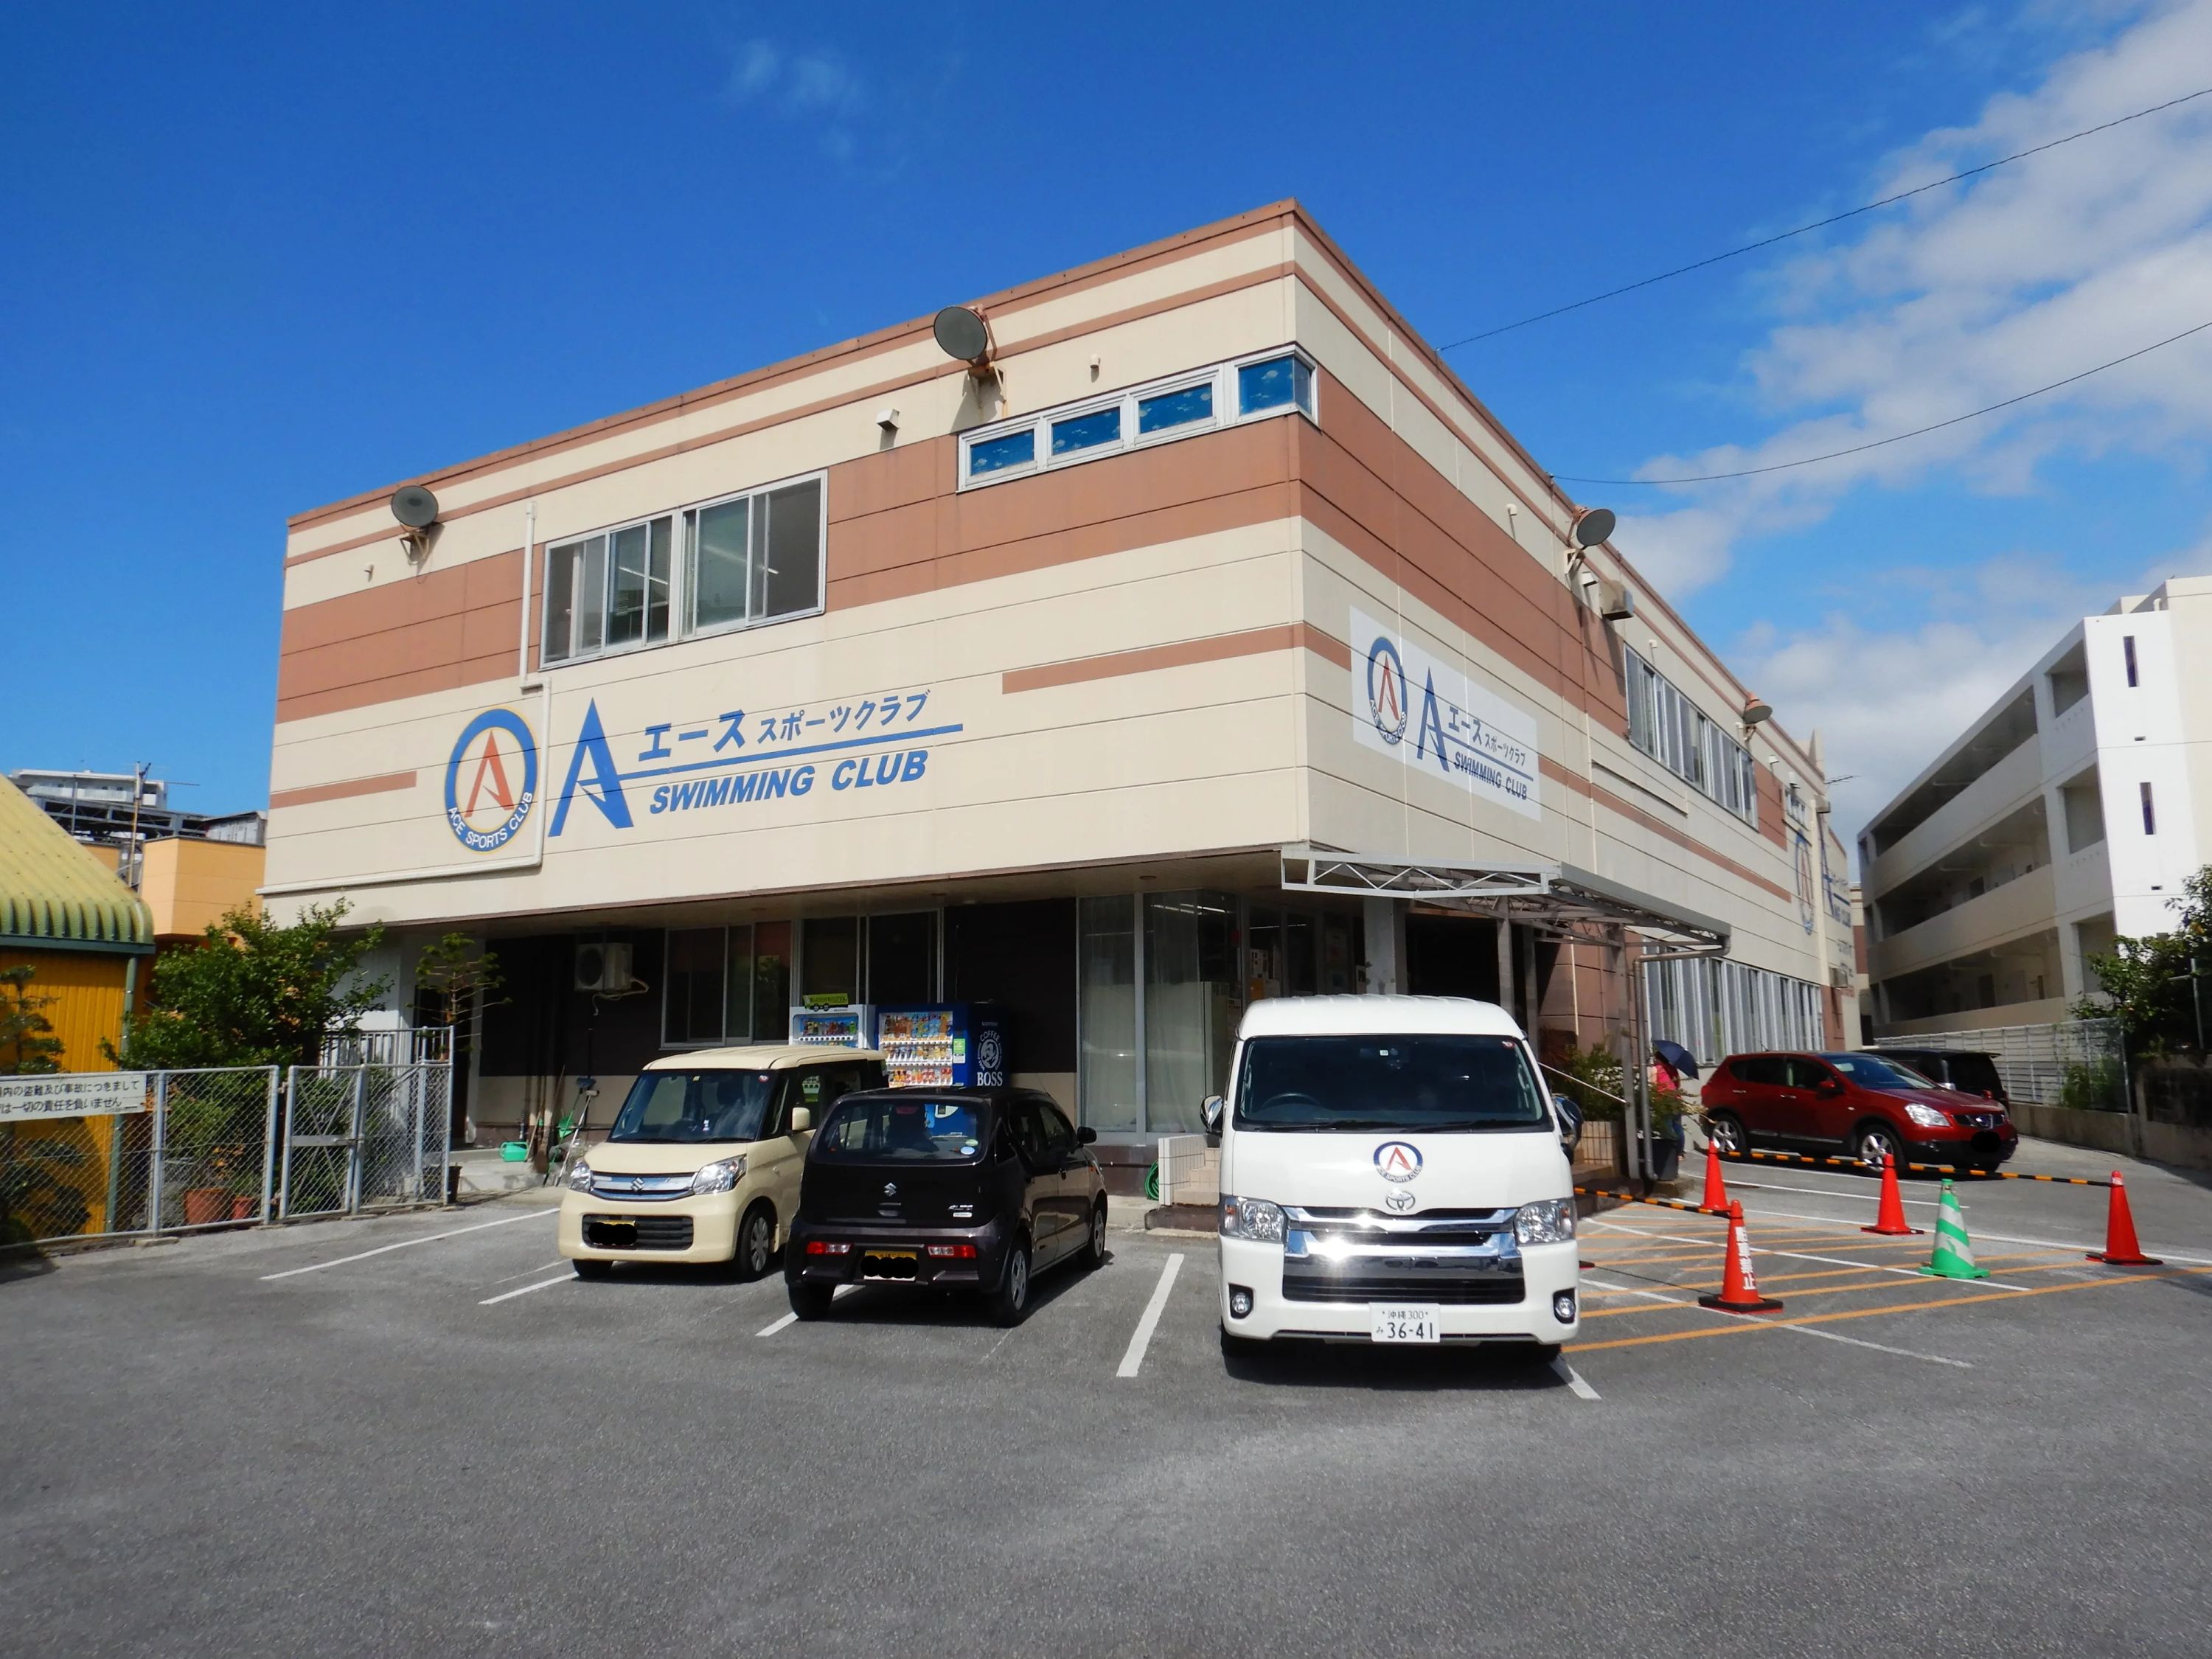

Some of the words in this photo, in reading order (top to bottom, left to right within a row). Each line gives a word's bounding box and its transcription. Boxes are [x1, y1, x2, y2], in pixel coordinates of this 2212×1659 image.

[639, 709, 745, 762] エース
[757, 689, 931, 744] スポーツクラブ
[1448, 706, 1482, 745] エース
[1485, 733, 1526, 766] スポーツクラブ
[650, 765, 815, 814] SWIMMING
[832, 750, 928, 790] CLUB
[1454, 751, 1502, 788] SWIMMING
[1506, 776, 1527, 800] CLUB
[448, 807, 466, 835] ACE
[465, 828, 508, 849] SPORTS
[509, 792, 532, 830] CLUB
[979, 1030, 1000, 1042] COFFEE
[977, 1071, 1003, 1086] BOSS
[0, 1097, 122, 1114] は一切の責任を負いません
[1387, 1322, 1433, 1339] 36-41
[1408, 1310, 1425, 1320] 300
